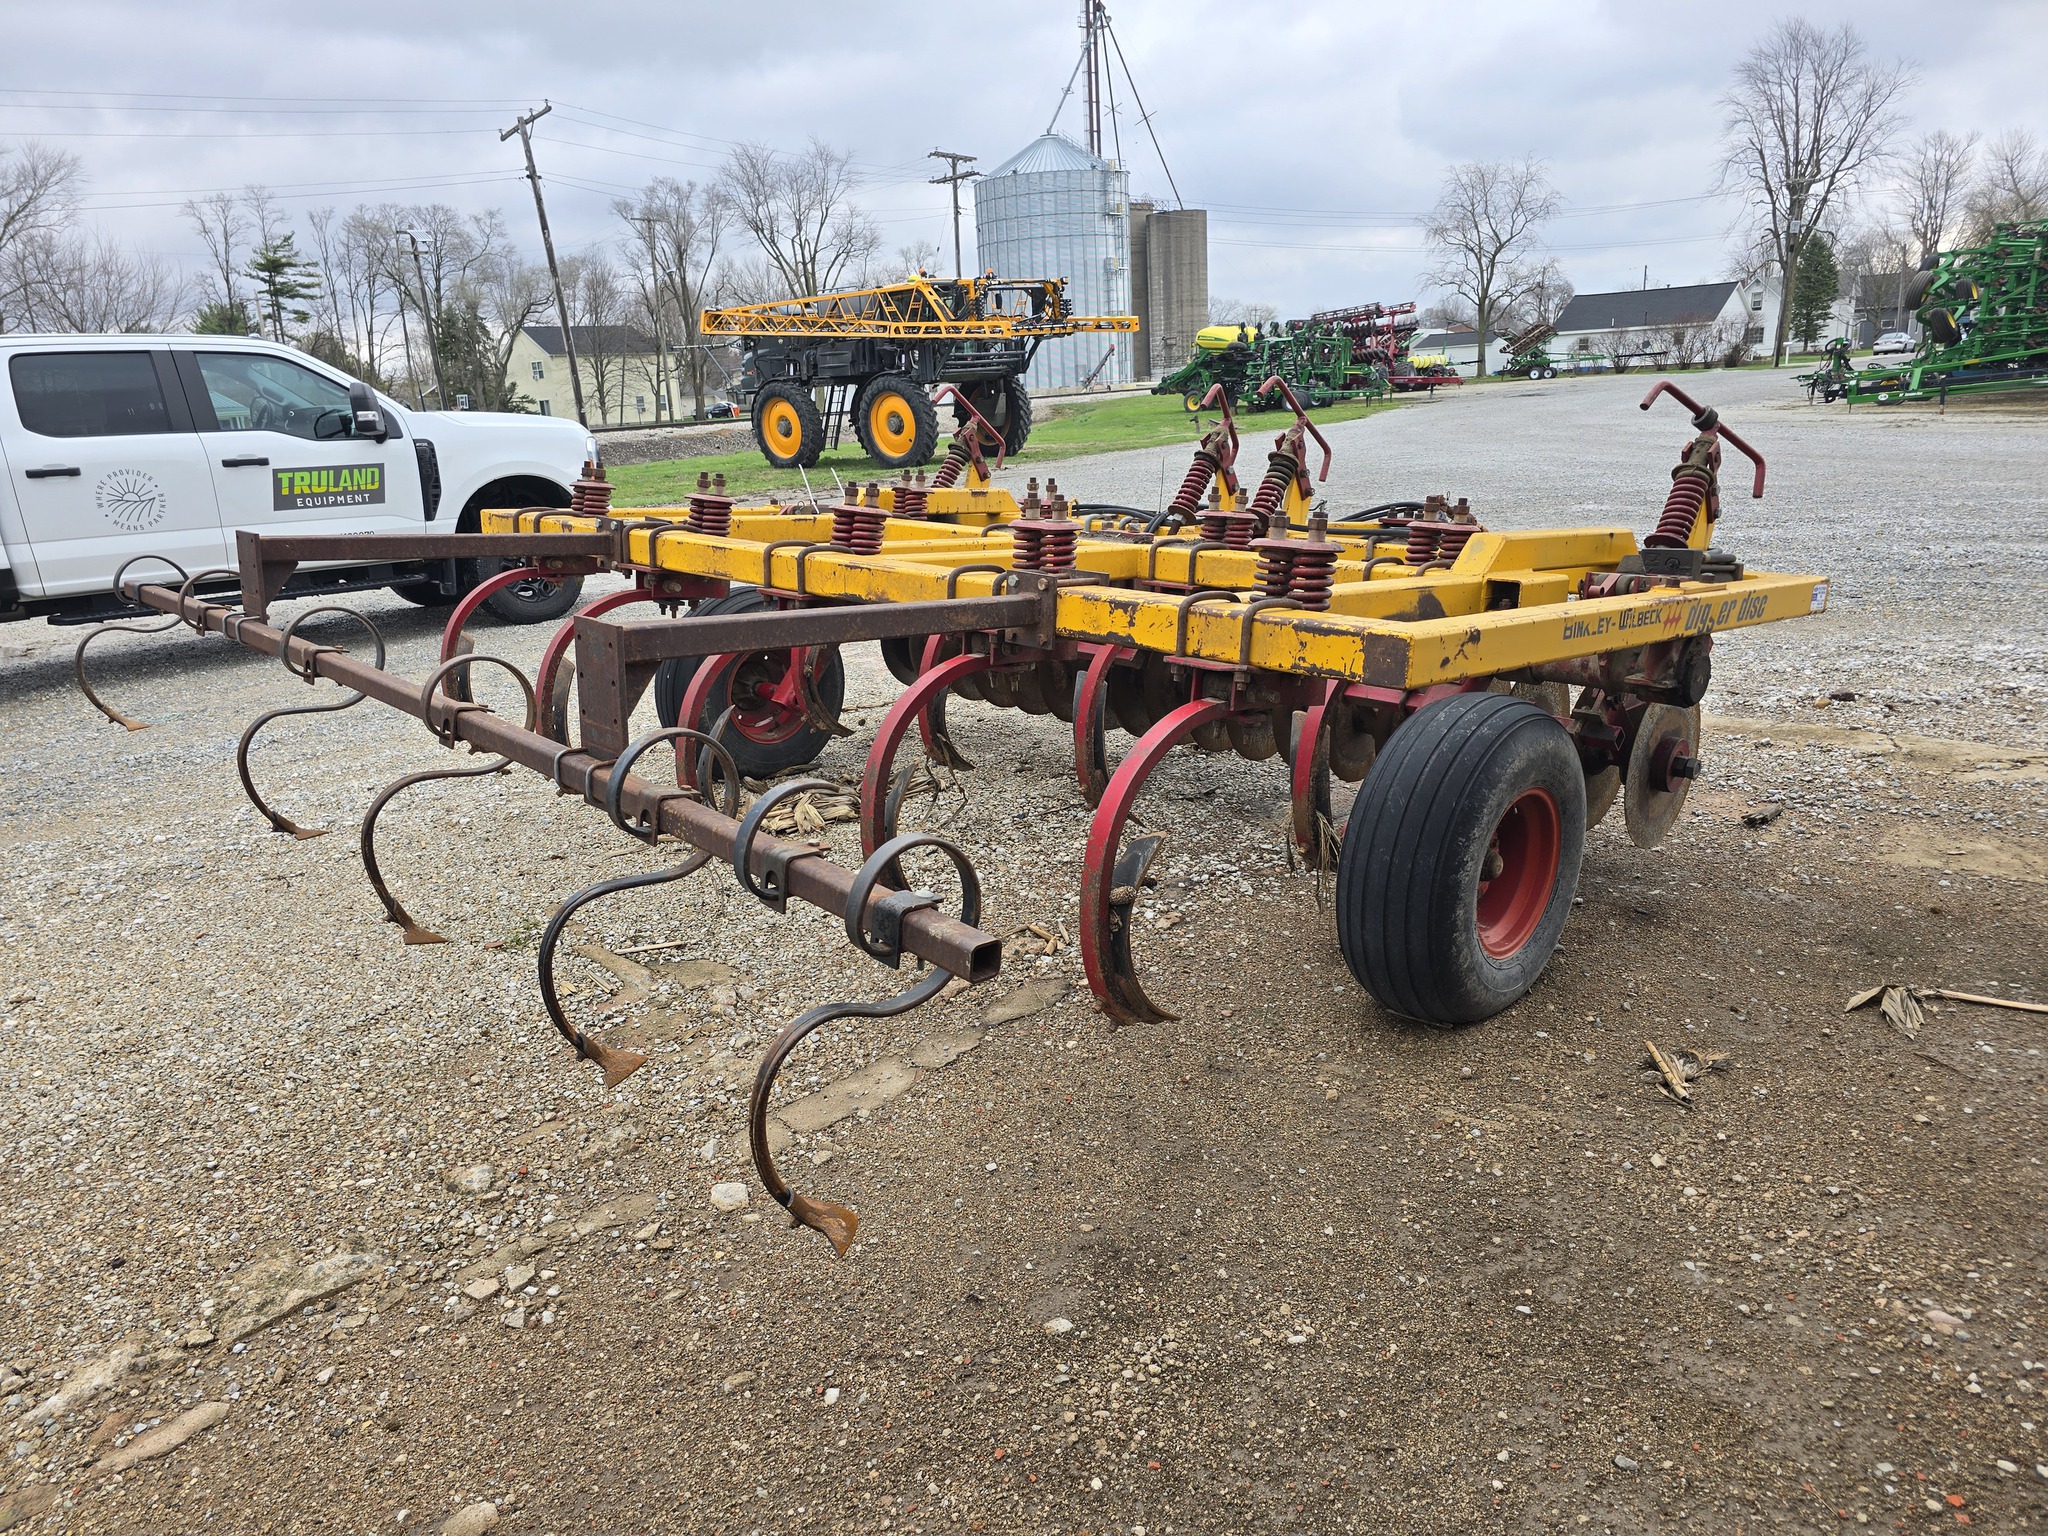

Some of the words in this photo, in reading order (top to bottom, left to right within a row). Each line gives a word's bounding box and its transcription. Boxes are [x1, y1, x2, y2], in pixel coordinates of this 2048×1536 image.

[95, 479, 107, 509] WHERE
[106, 468, 154, 482] PROVIDER
[277, 467, 380, 495] TRULAND
[112, 519, 145, 532] MEANS
[147, 492, 167, 528] PARTNER
[296, 493, 370, 507] EQUIPMENT
